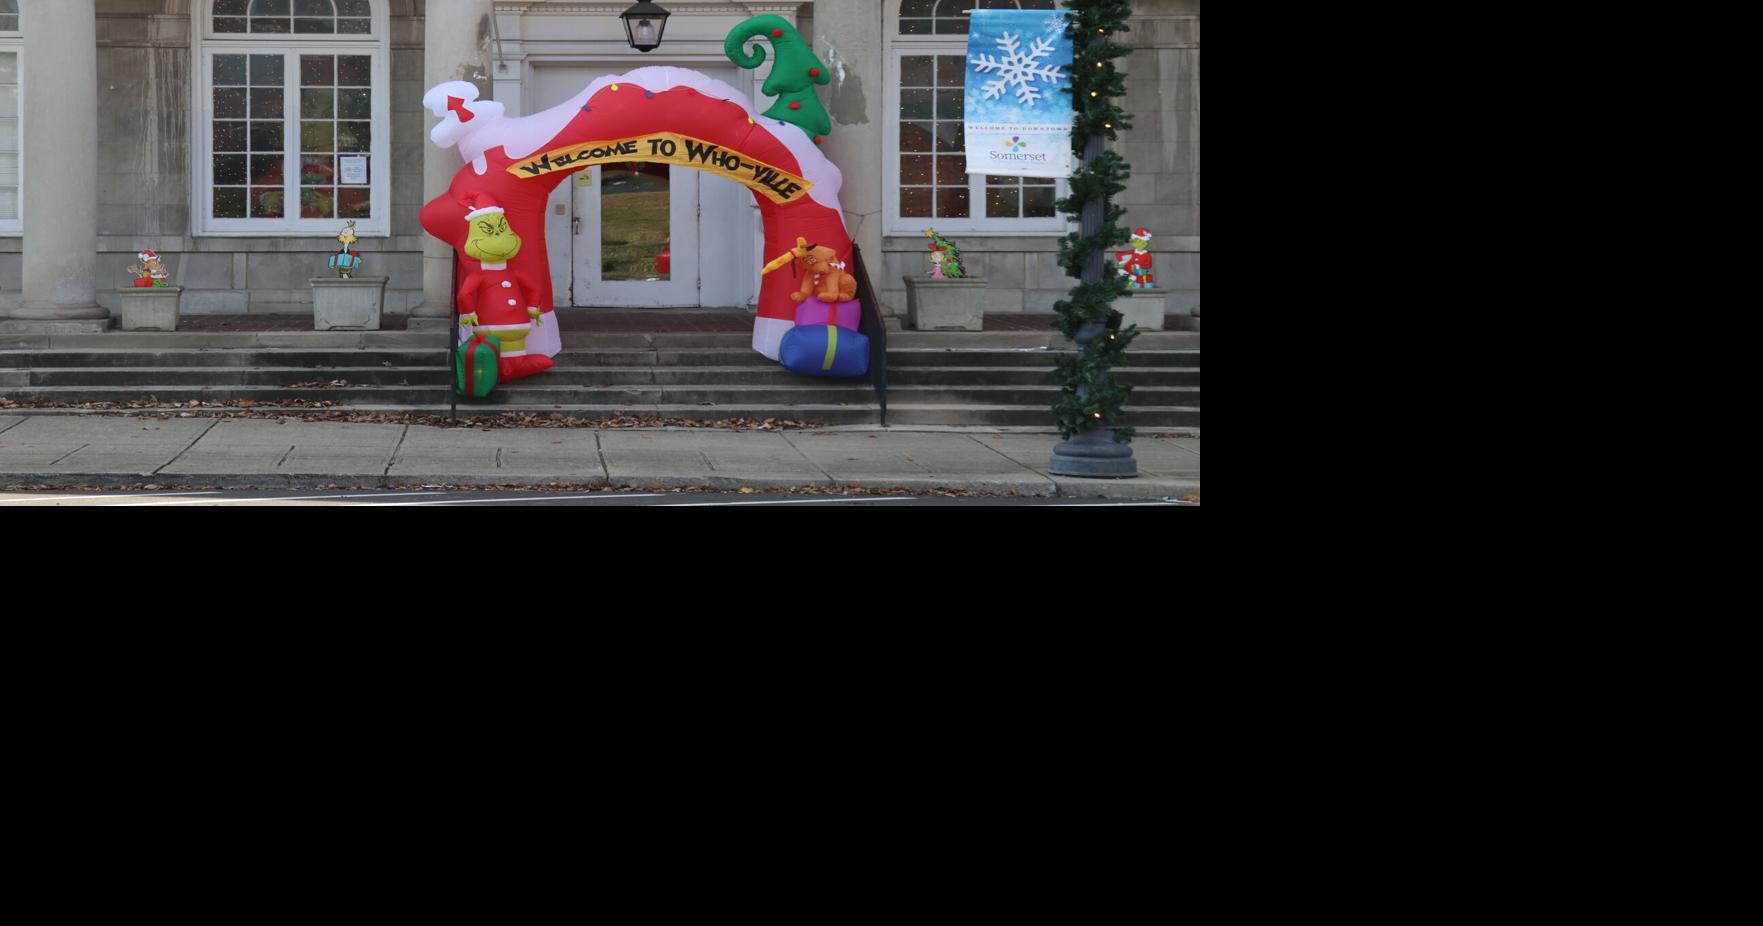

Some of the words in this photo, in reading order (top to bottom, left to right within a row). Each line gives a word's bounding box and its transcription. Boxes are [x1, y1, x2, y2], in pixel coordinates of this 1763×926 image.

[520, 140, 637, 175] WELCOME
[648, 139, 676, 157] TO
[685, 140, 802, 199] WHO-VILLE
[990, 150, 1047, 161] Somerset
